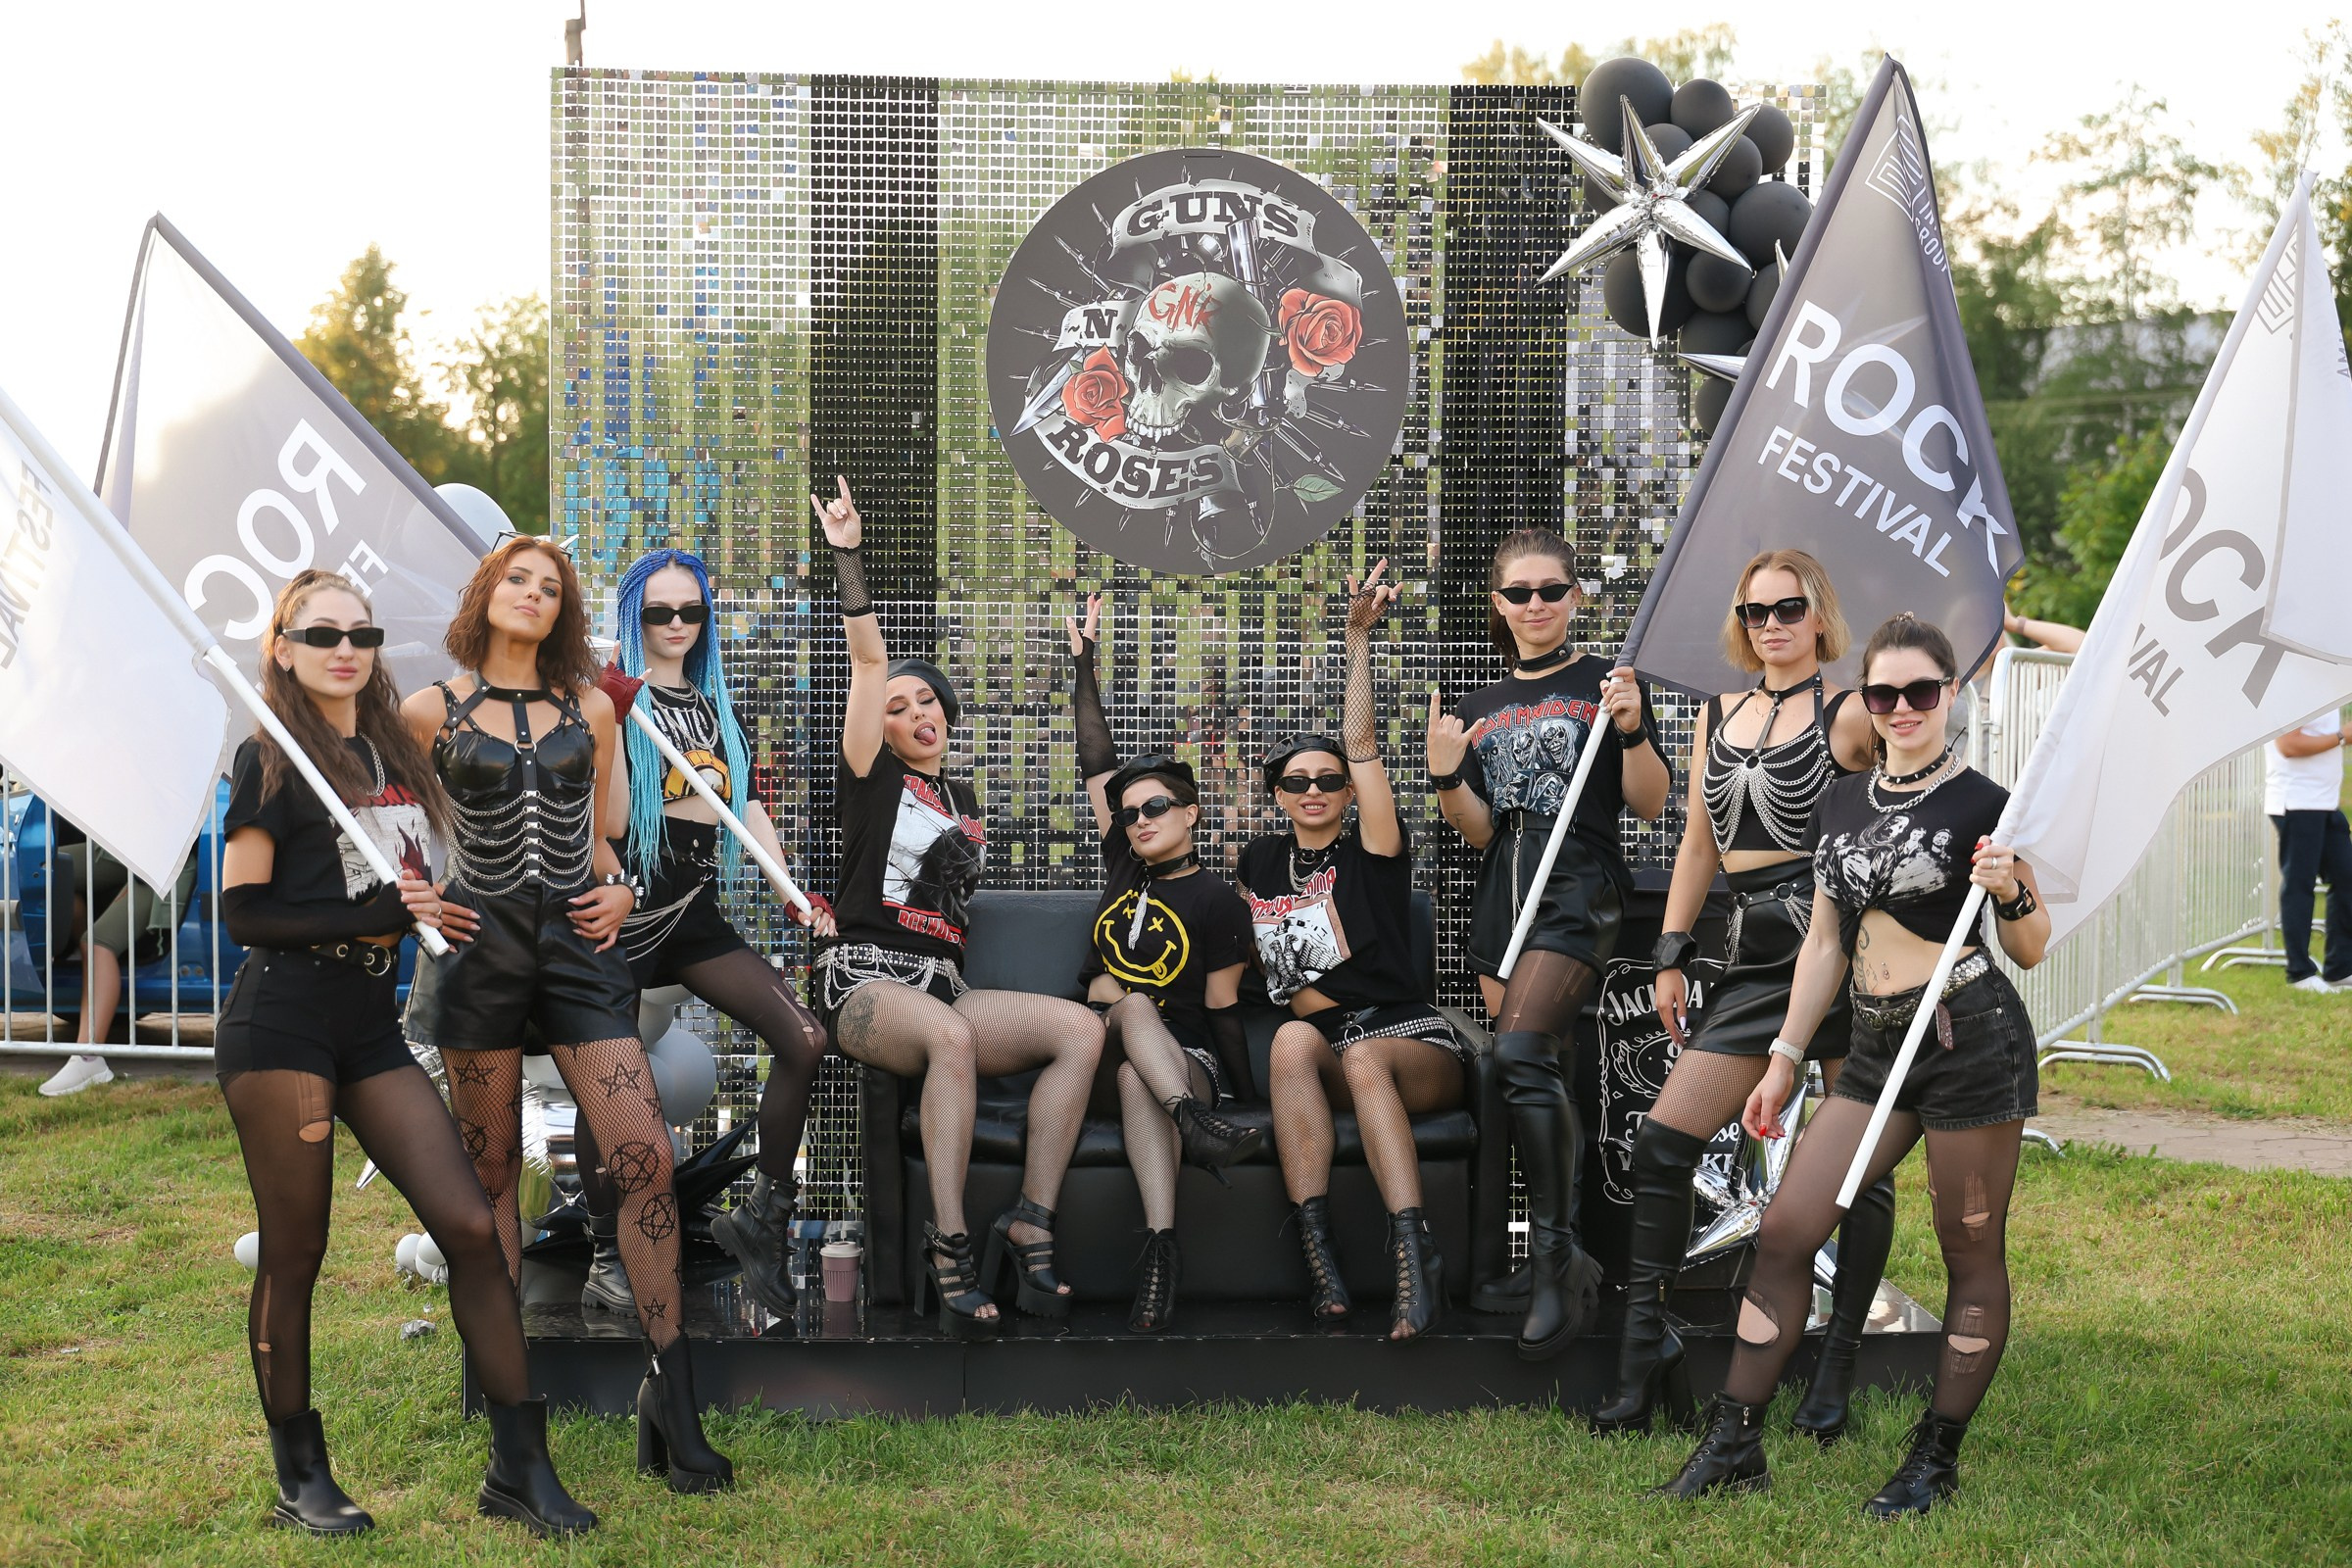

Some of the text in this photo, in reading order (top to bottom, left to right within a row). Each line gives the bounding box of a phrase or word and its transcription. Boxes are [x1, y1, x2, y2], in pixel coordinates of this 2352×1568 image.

[1126, 190, 1299, 238] GUNS
[1045, 419, 1224, 500] ROSES
[1757, 424, 1953, 578] FESTIVAL
[1514, 699, 1599, 732] MAIDEN
